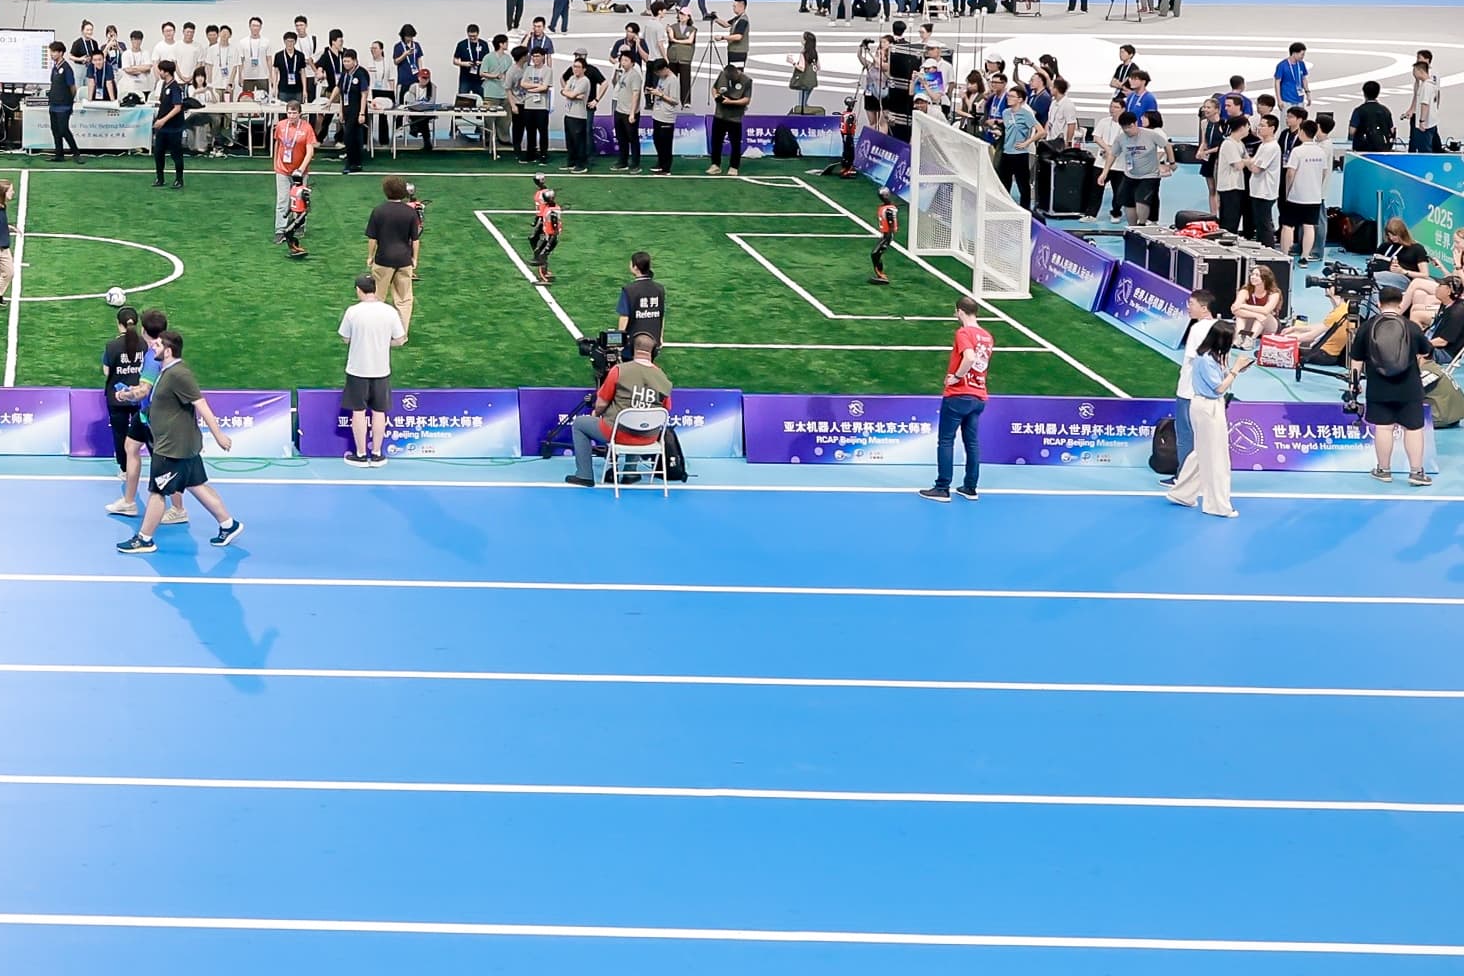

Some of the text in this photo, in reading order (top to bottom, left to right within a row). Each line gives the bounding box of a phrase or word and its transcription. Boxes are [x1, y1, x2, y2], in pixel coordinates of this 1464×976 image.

[1427, 204, 1454, 230] 2025
[639, 296, 659, 308] 裁判
[632, 385, 656, 404] HB
[783, 420, 932, 434] 亚太机器人世界杯北京大师赛
[391, 430, 452, 440] Beijing Masters
[816, 435, 838, 444] RCAP
[839, 435, 865, 445] Beijing
[1043, 437, 1129, 448] RCAP Beijing Masters
[1274, 442, 1364, 451] The World Humanoid
